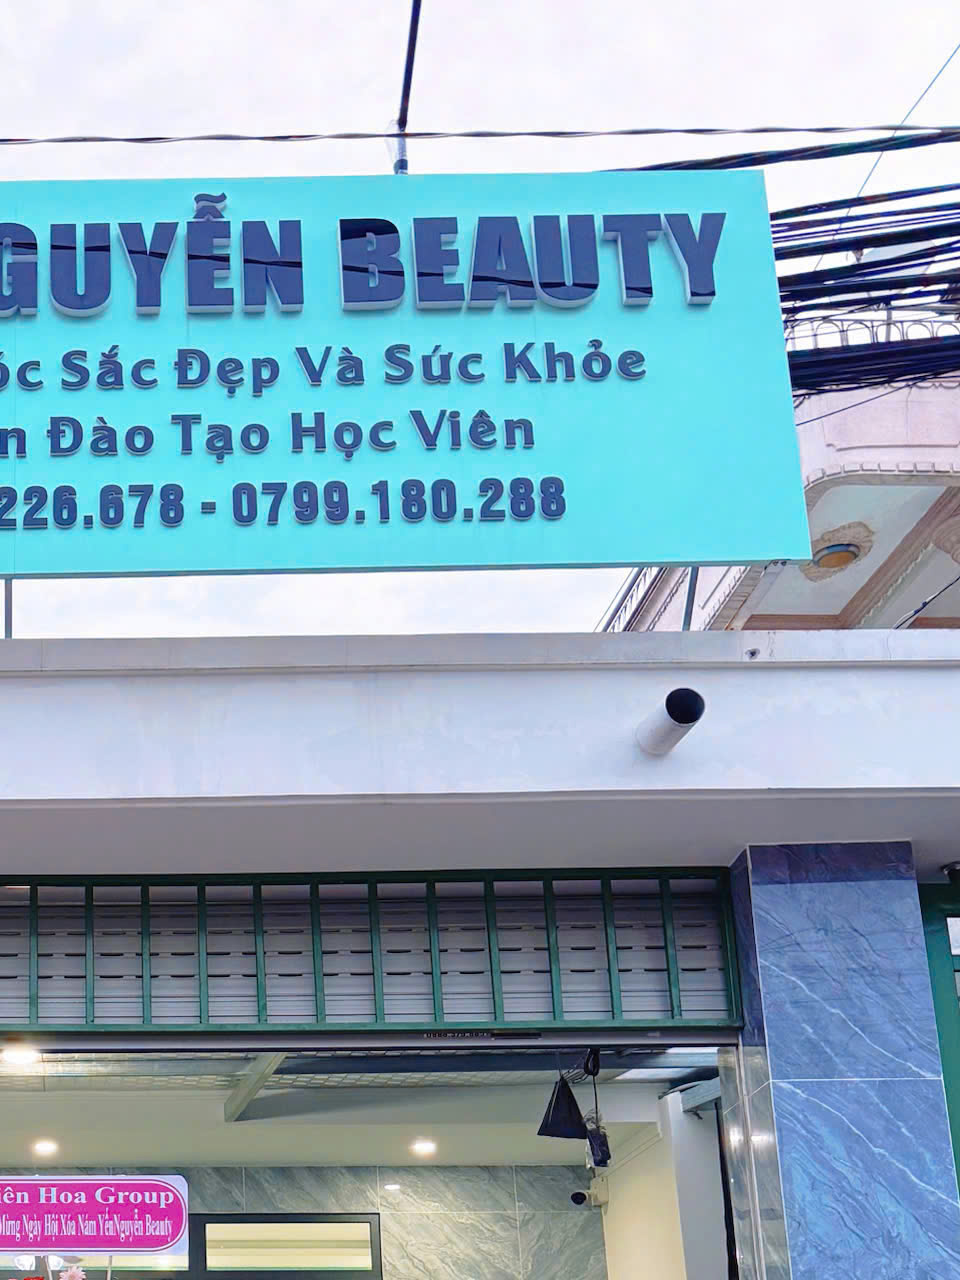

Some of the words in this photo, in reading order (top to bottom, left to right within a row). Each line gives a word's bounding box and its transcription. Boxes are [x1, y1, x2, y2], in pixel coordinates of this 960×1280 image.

[338, 213, 726, 310] BEAUTY
[61, 345, 158, 390] Sắc
[174, 348, 280, 397] Đẹp
[295, 346, 365, 386] Và
[384, 343, 486, 383] Sức
[504, 339, 647, 382] Khỏe
[47, 417, 155, 456] Đào
[171, 414, 269, 463] Tạo
[291, 412, 396, 461] Học
[409, 410, 535, 450] Viên
[232, 477, 567, 526] 0799.180.288
[38, 1187, 86, 1204] Hoa
[95, 1186, 174, 1208] Group
[22, 1213, 41, 1241] Ngày
[145, 1213, 173, 1242] Beauty
